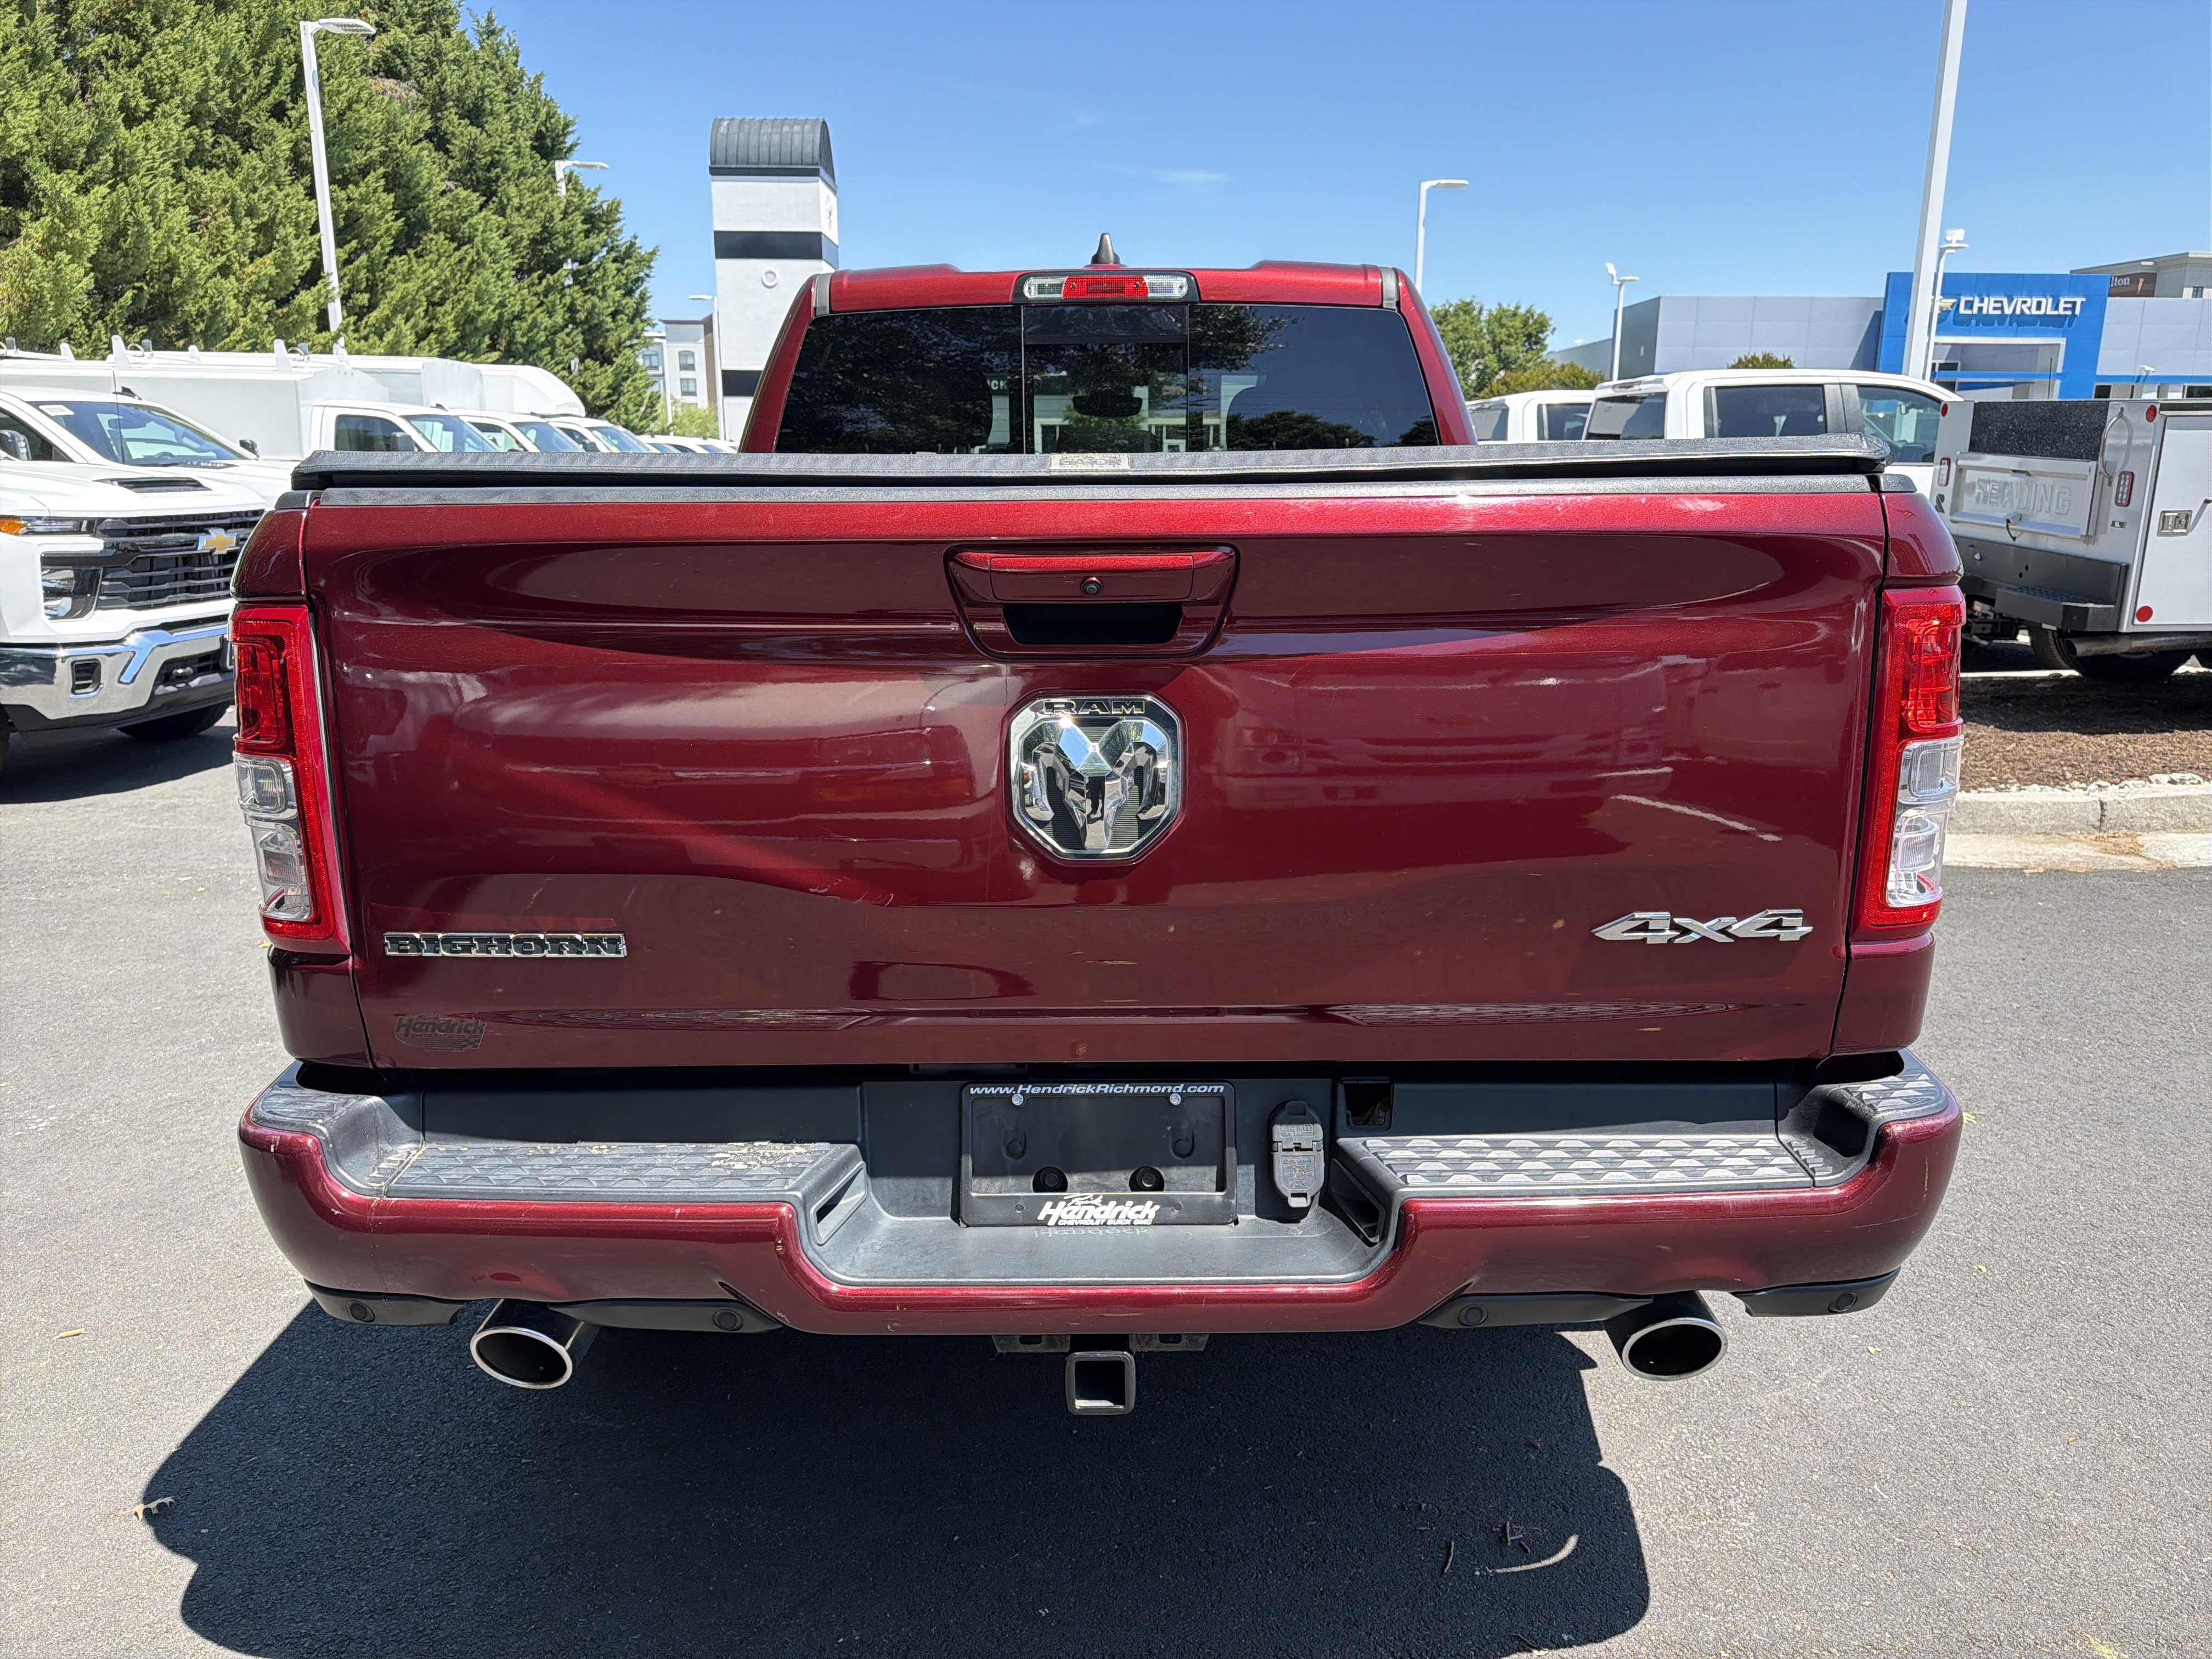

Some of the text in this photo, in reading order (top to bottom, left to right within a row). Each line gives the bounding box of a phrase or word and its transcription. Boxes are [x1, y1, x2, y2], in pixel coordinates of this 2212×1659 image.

[2111, 276, 2131, 287] lton
[1959, 296, 2086, 315] CHEVROLET
[1975, 477, 2072, 516] READING
[1042, 701, 1145, 714] RAM
[383, 932, 628, 958] BIGHORN
[395, 1017, 487, 1037] Hendrick
[970, 1084, 1224, 1094] www.HendrickRichmond.com
[1037, 1200, 1160, 1226] Hendrick
